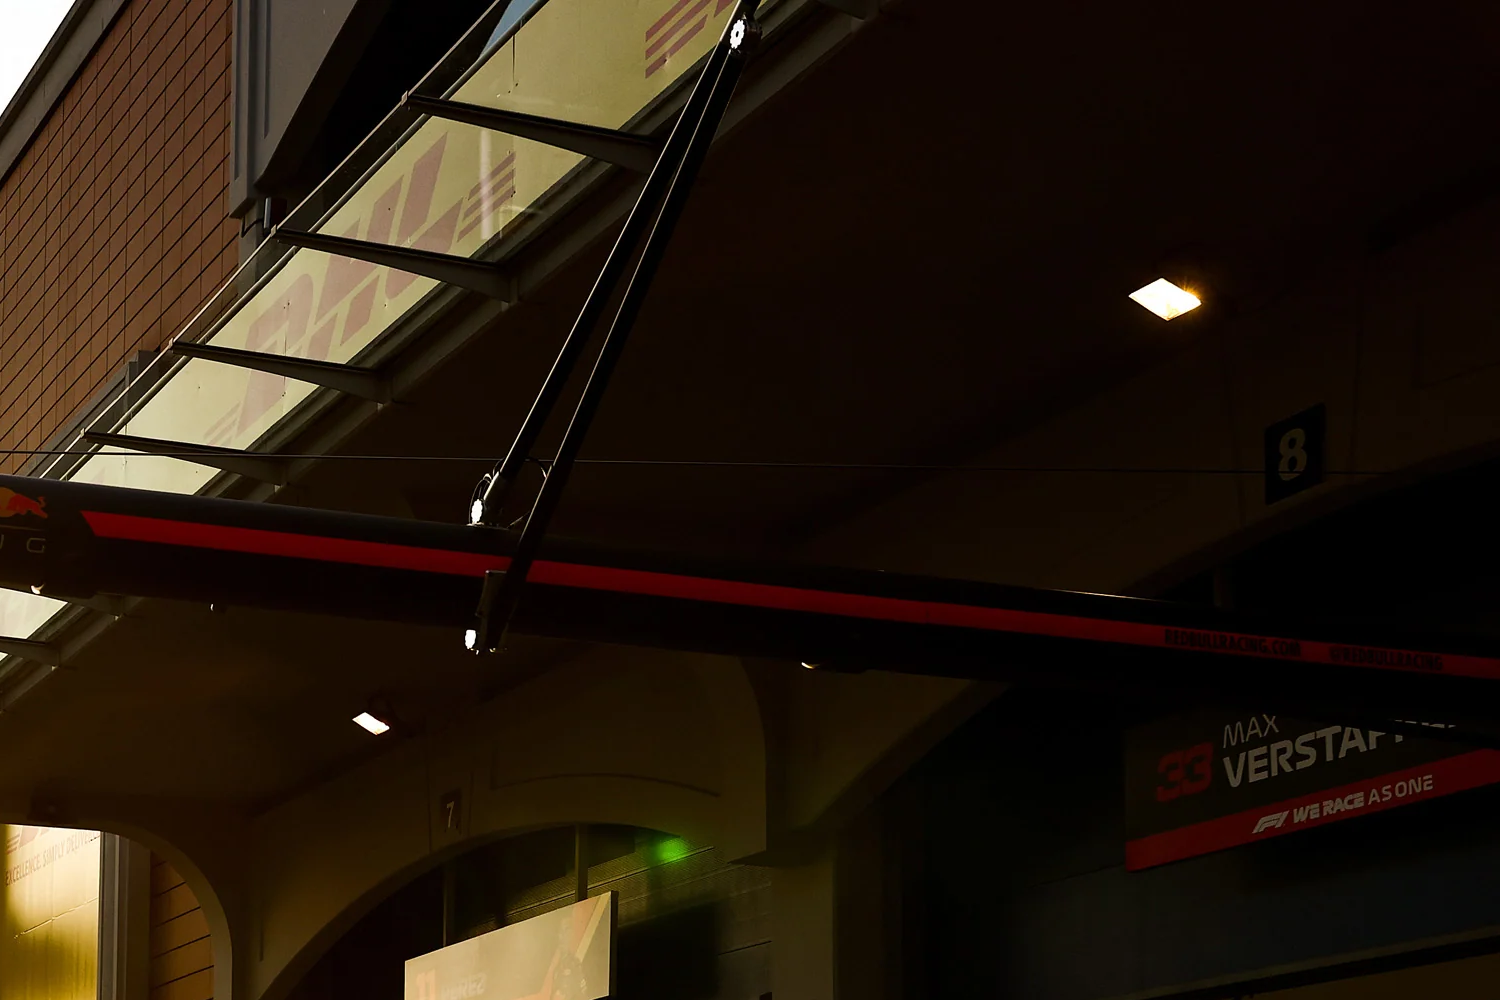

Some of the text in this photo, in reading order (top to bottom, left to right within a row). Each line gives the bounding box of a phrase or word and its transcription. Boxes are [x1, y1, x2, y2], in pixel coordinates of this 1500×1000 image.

[1278, 428, 1308, 481] 8
[1222, 718, 1456, 789] VERSTA
[1223, 714, 1280, 749] MAX
[1155, 742, 1214, 802] 33
[1293, 804, 1320, 824] WE
[1321, 791, 1366, 817] RACE
[1368, 784, 1392, 806] AS
[1394, 775, 1434, 800] ONE
